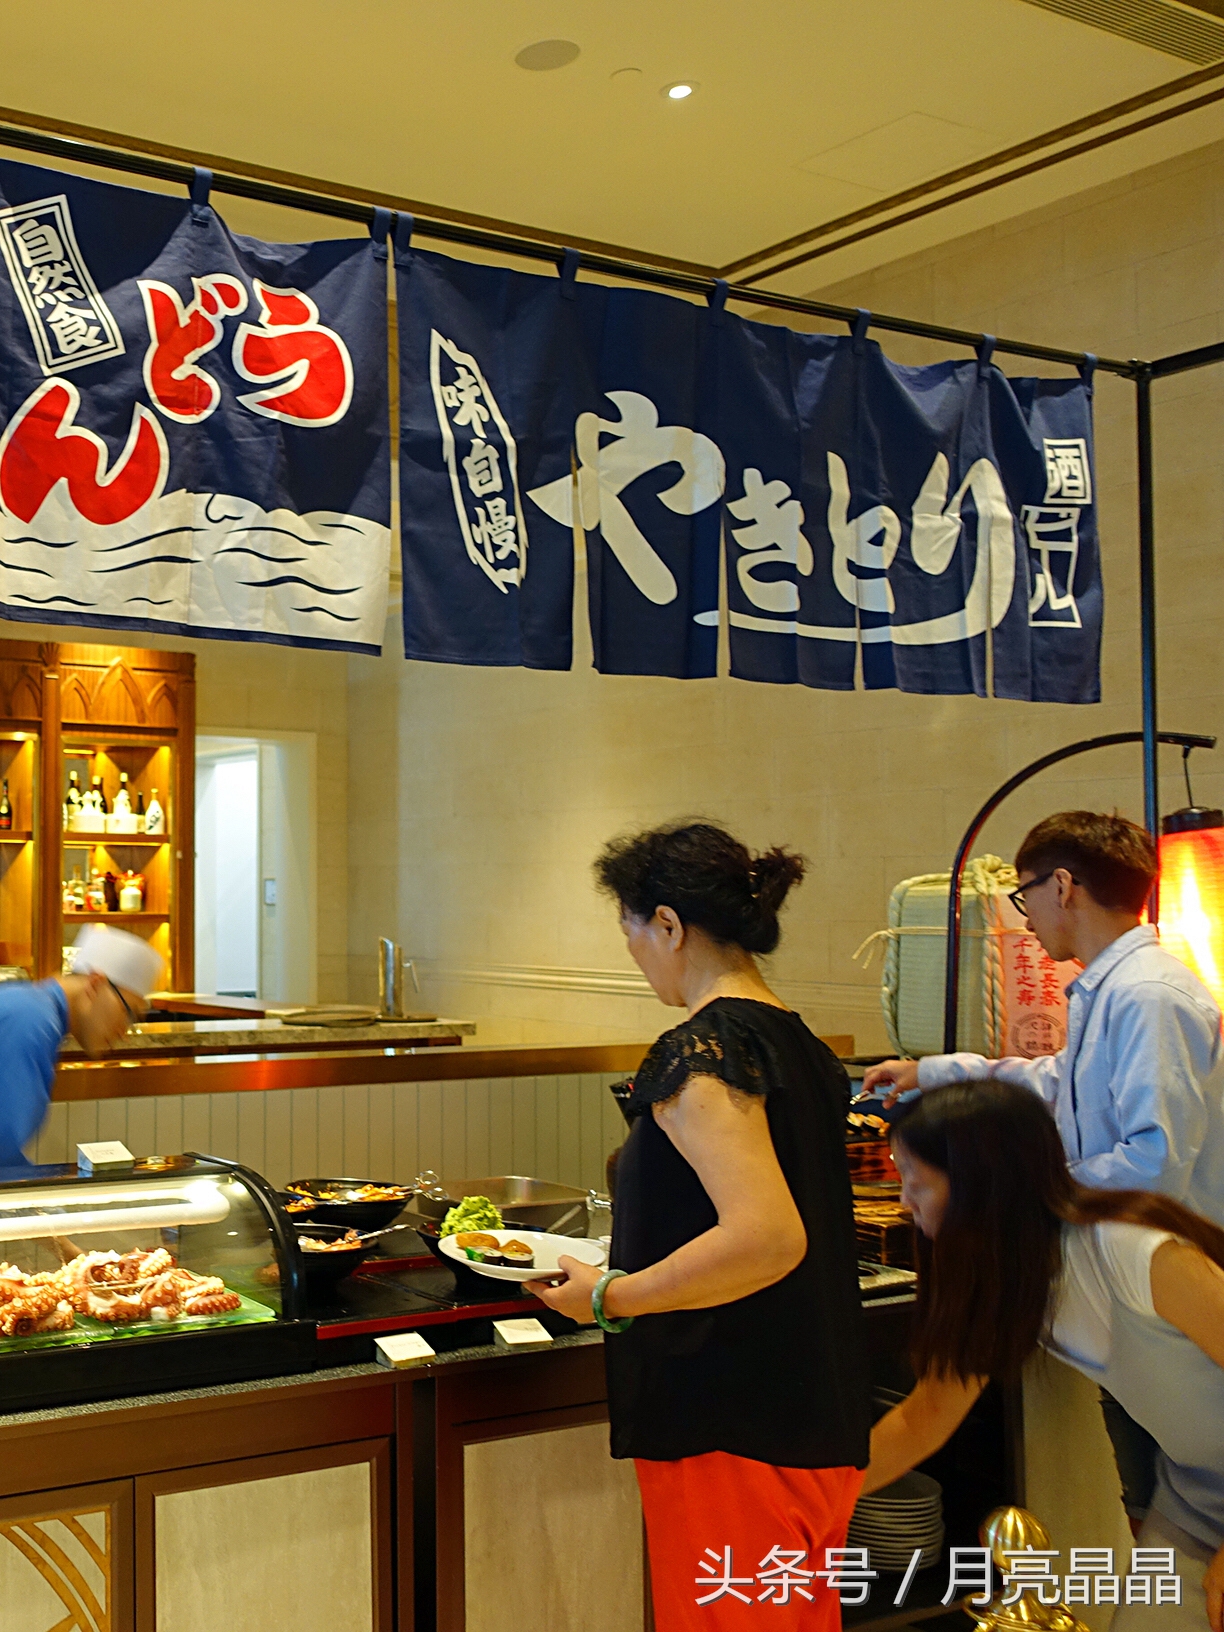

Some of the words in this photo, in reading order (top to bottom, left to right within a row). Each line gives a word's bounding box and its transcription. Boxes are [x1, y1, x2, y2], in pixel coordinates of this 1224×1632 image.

[14, 219, 103, 354] 自然食
[441, 367, 520, 564] 味自慢
[528, 391, 1015, 645] やきとり
